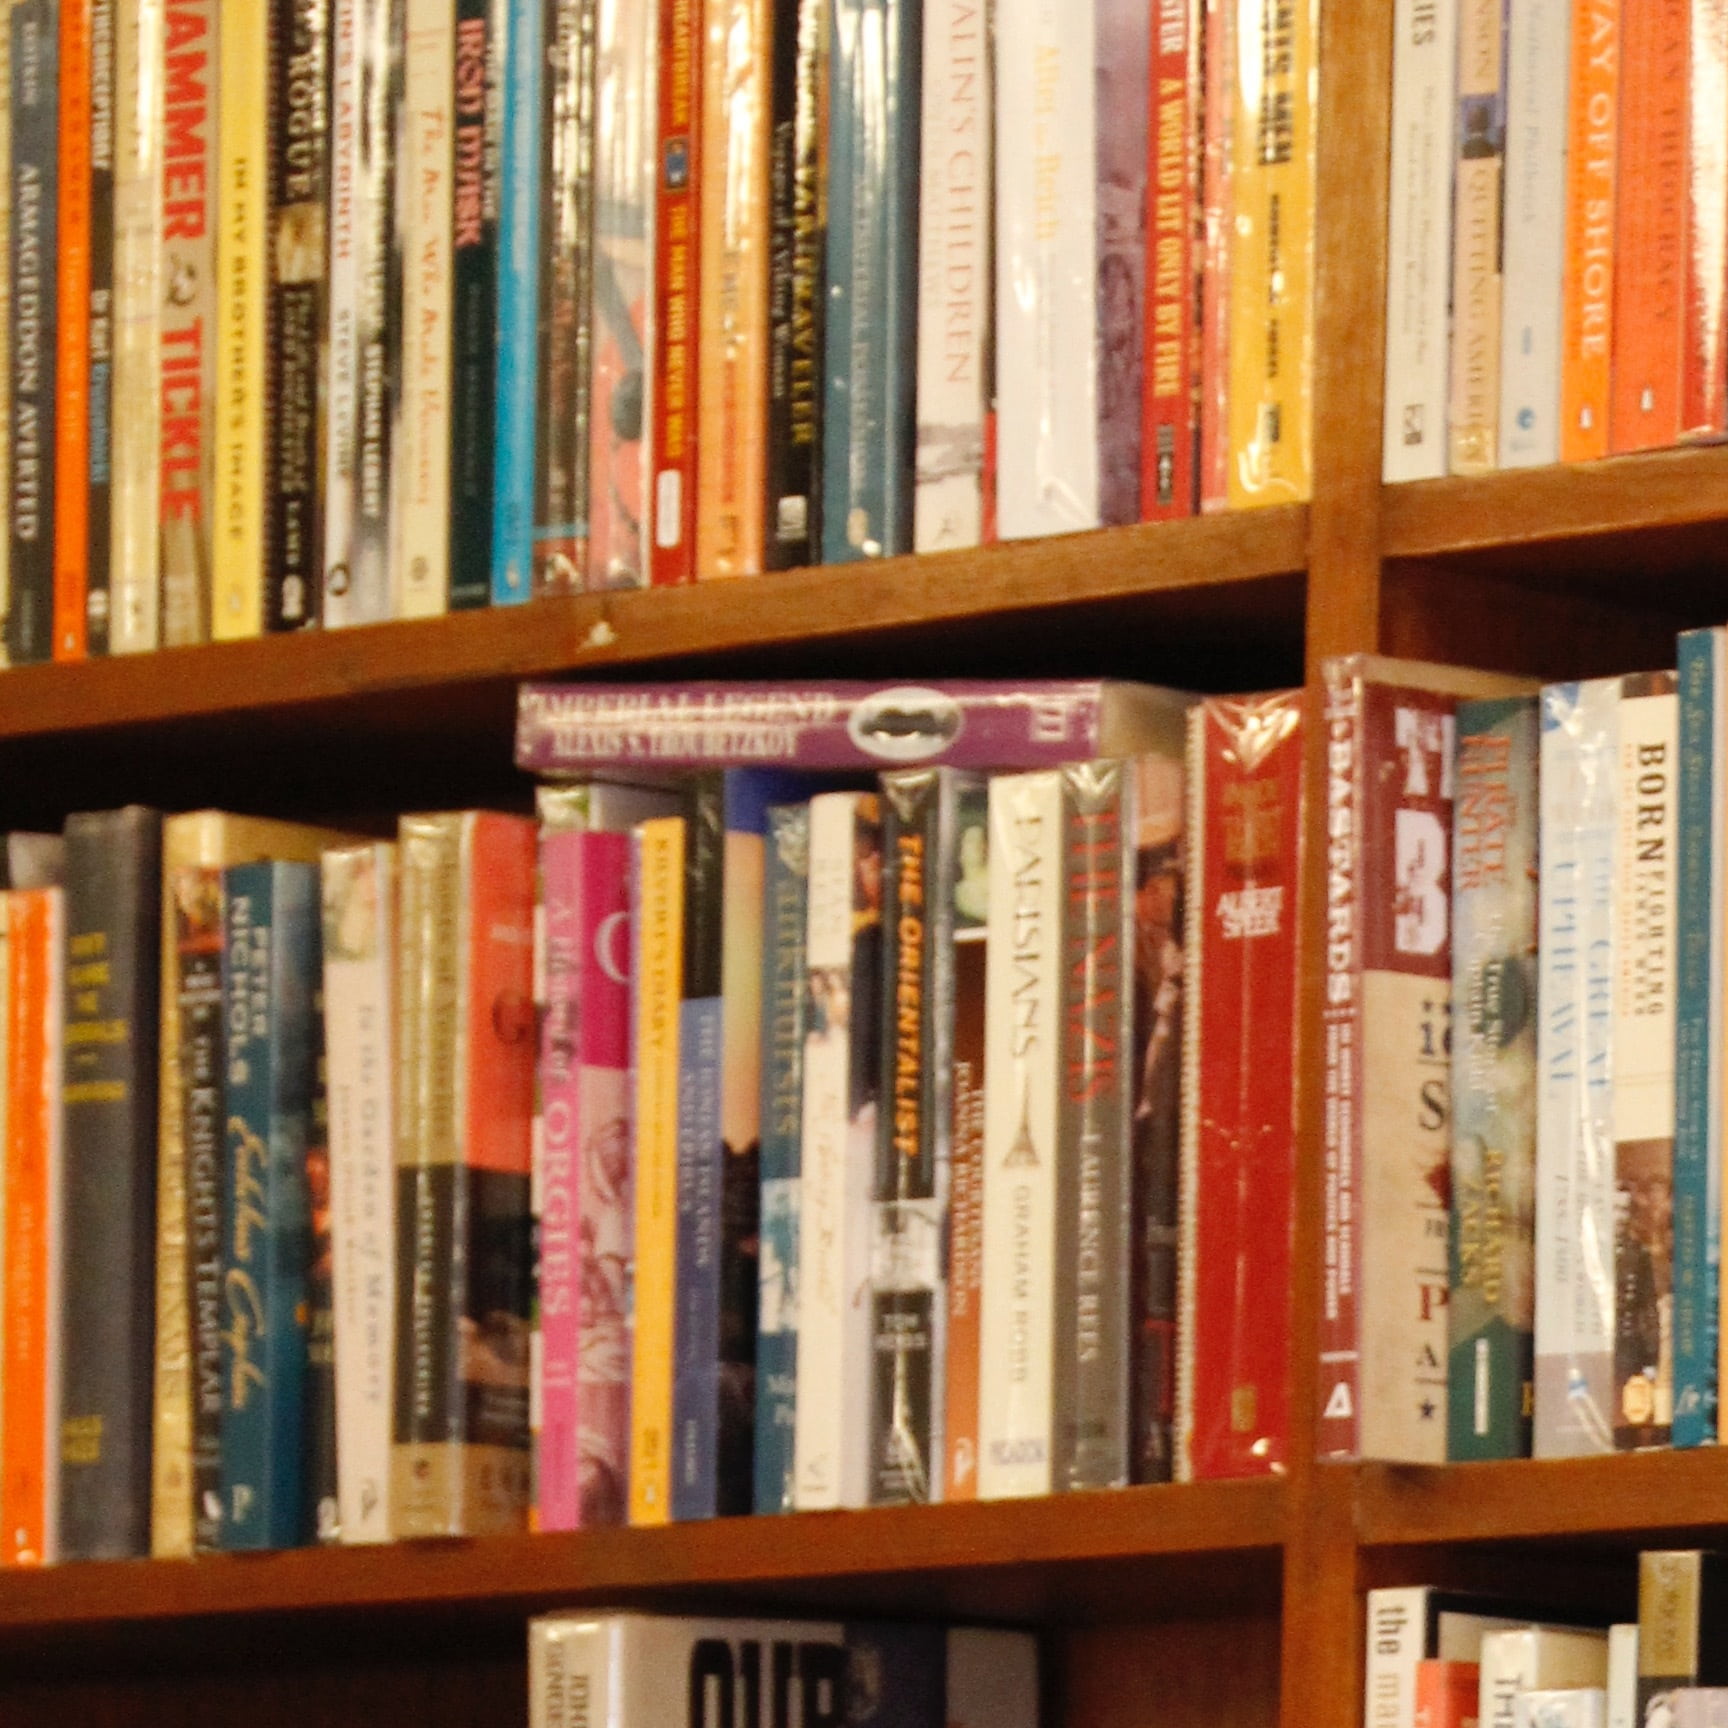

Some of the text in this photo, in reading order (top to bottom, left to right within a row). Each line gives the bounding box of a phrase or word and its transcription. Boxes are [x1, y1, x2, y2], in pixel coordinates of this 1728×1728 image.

[1155, 102, 1184, 188] WORLD
[15, 163, 38, 540] ARMAGEDDON AVERTED
[1154, 305, 1182, 336] BY
[1155, 238, 1183, 297] ONLY
[160, 318, 205, 525] TICKLE
[229, 897, 251, 1084] NICHOLS
[254, 926, 269, 1036] PETER
[894, 834, 923, 1158] THE ORIENTALIST
[1011, 813, 1044, 1061] PARISIANS
